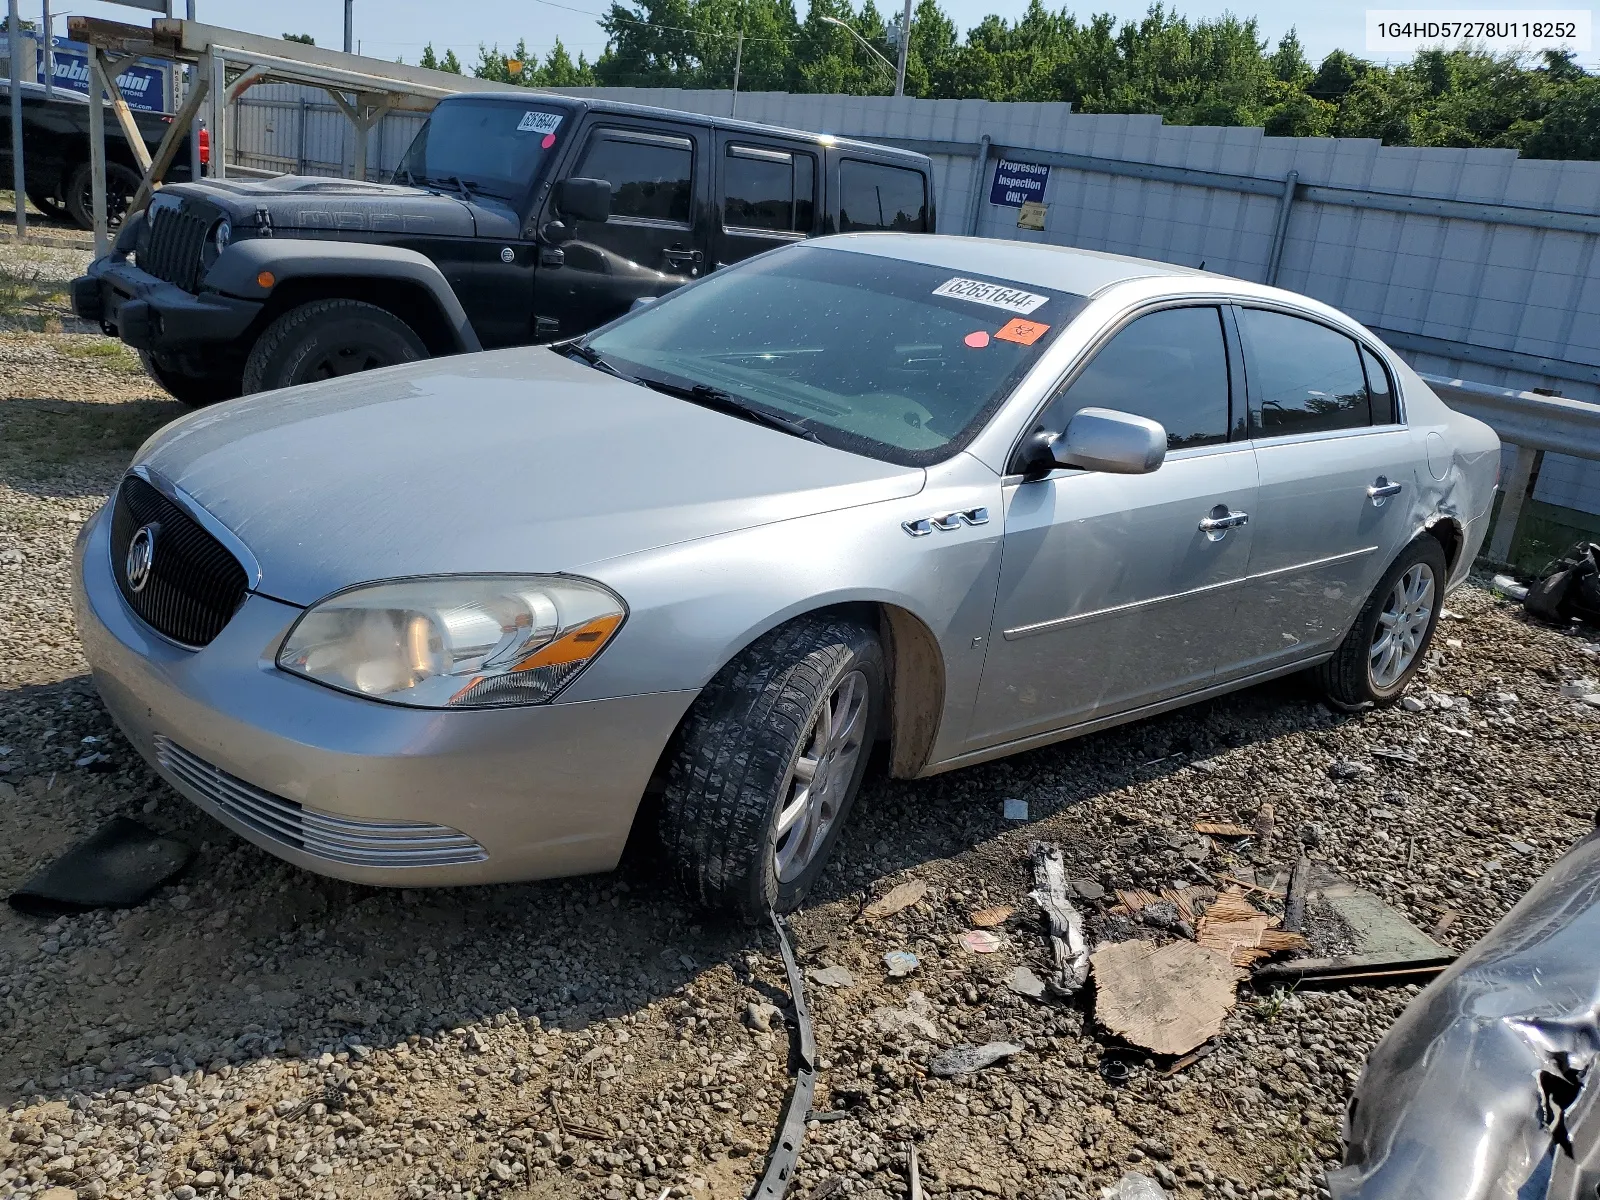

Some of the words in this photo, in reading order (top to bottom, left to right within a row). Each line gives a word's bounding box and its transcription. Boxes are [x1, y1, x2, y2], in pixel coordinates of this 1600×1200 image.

[998, 159, 1048, 175] Progressive
[998, 175, 1041, 190] Inspection
[1005, 191, 1028, 203] ONLY
